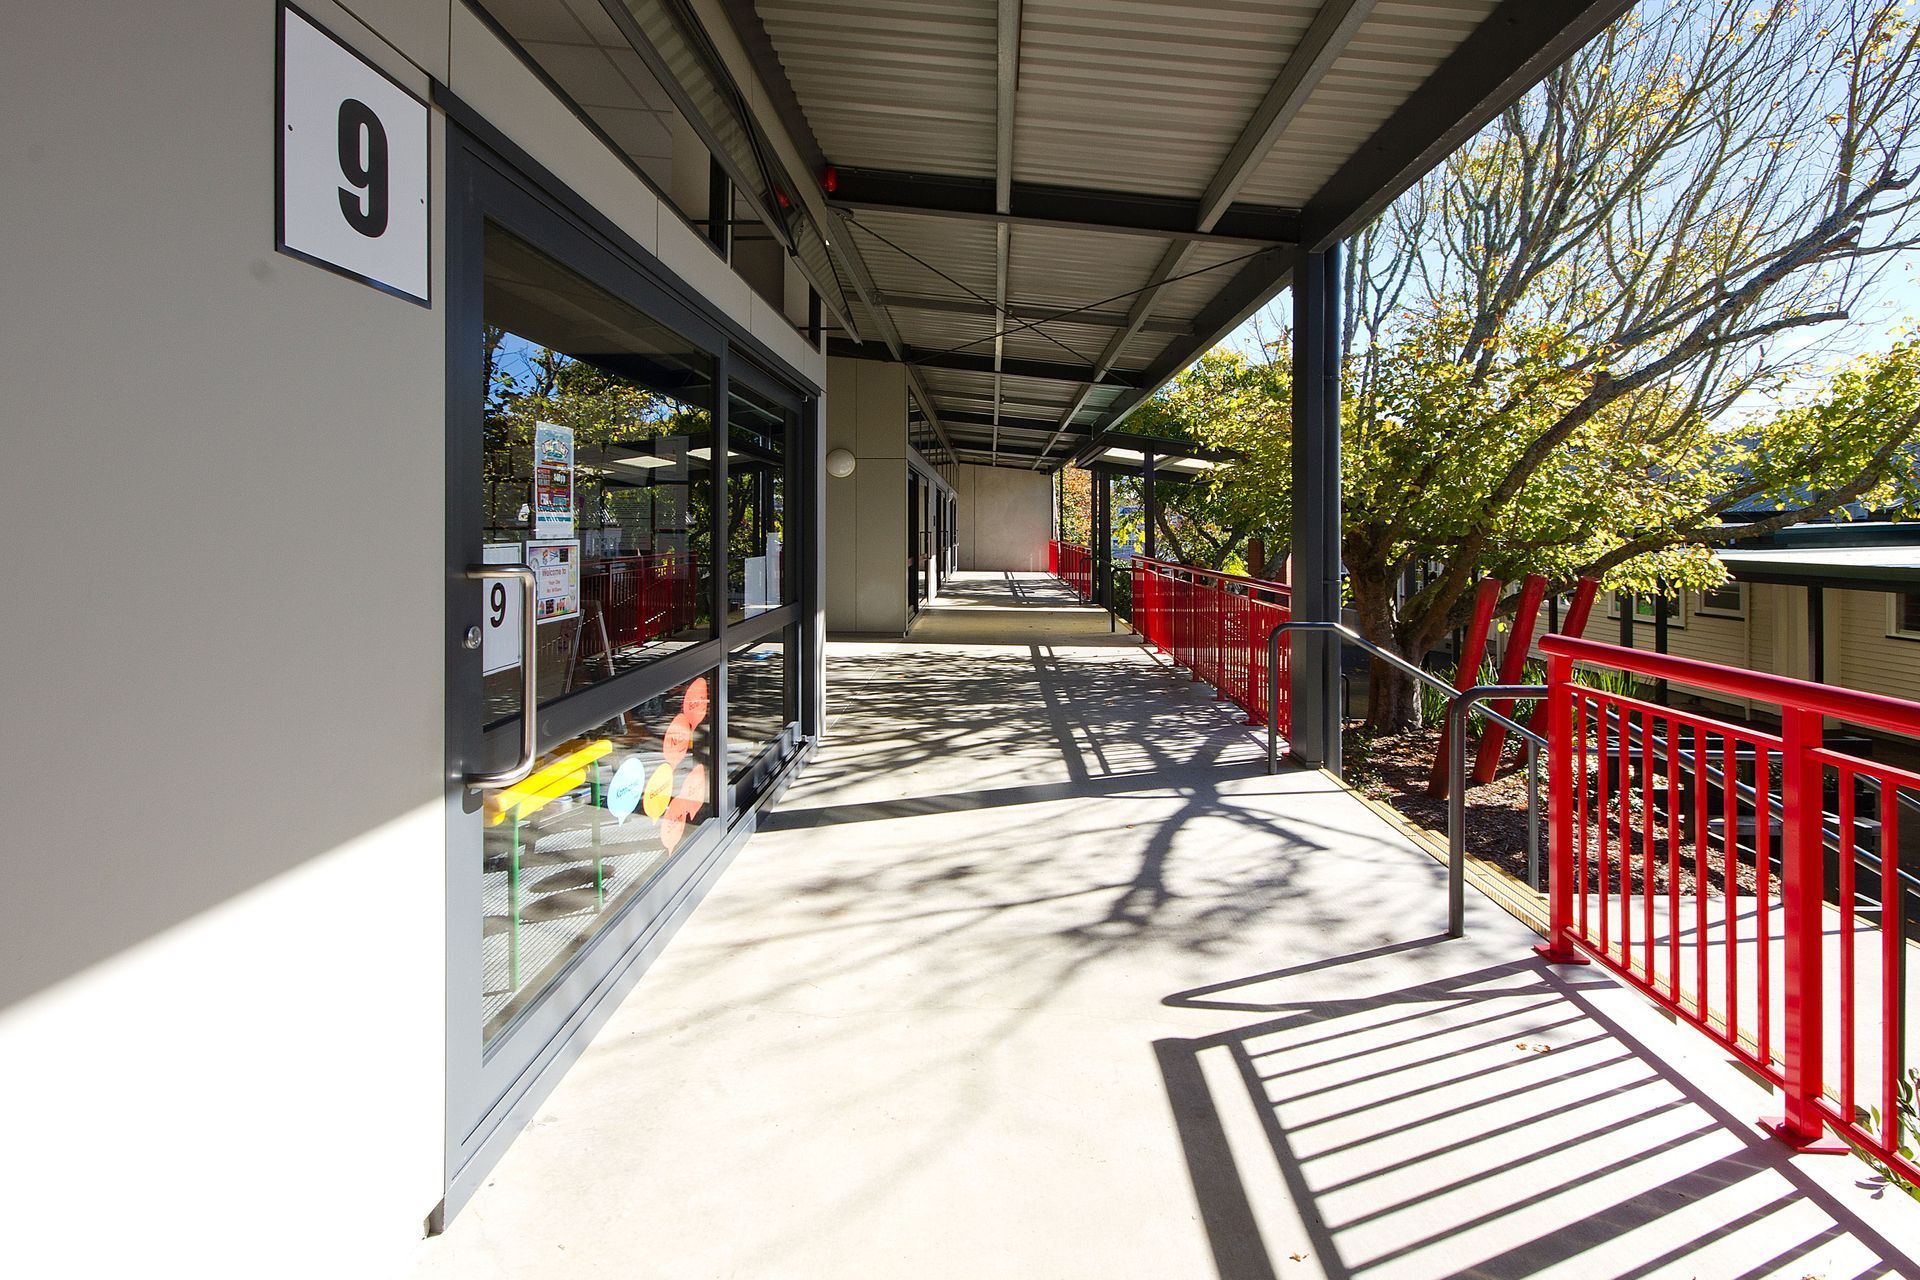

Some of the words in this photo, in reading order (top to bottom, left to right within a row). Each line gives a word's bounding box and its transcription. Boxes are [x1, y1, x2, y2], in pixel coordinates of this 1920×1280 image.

[337, 98, 389, 238] 9
[542, 568, 561, 576] Welcome
[490, 582, 506, 628] 9
